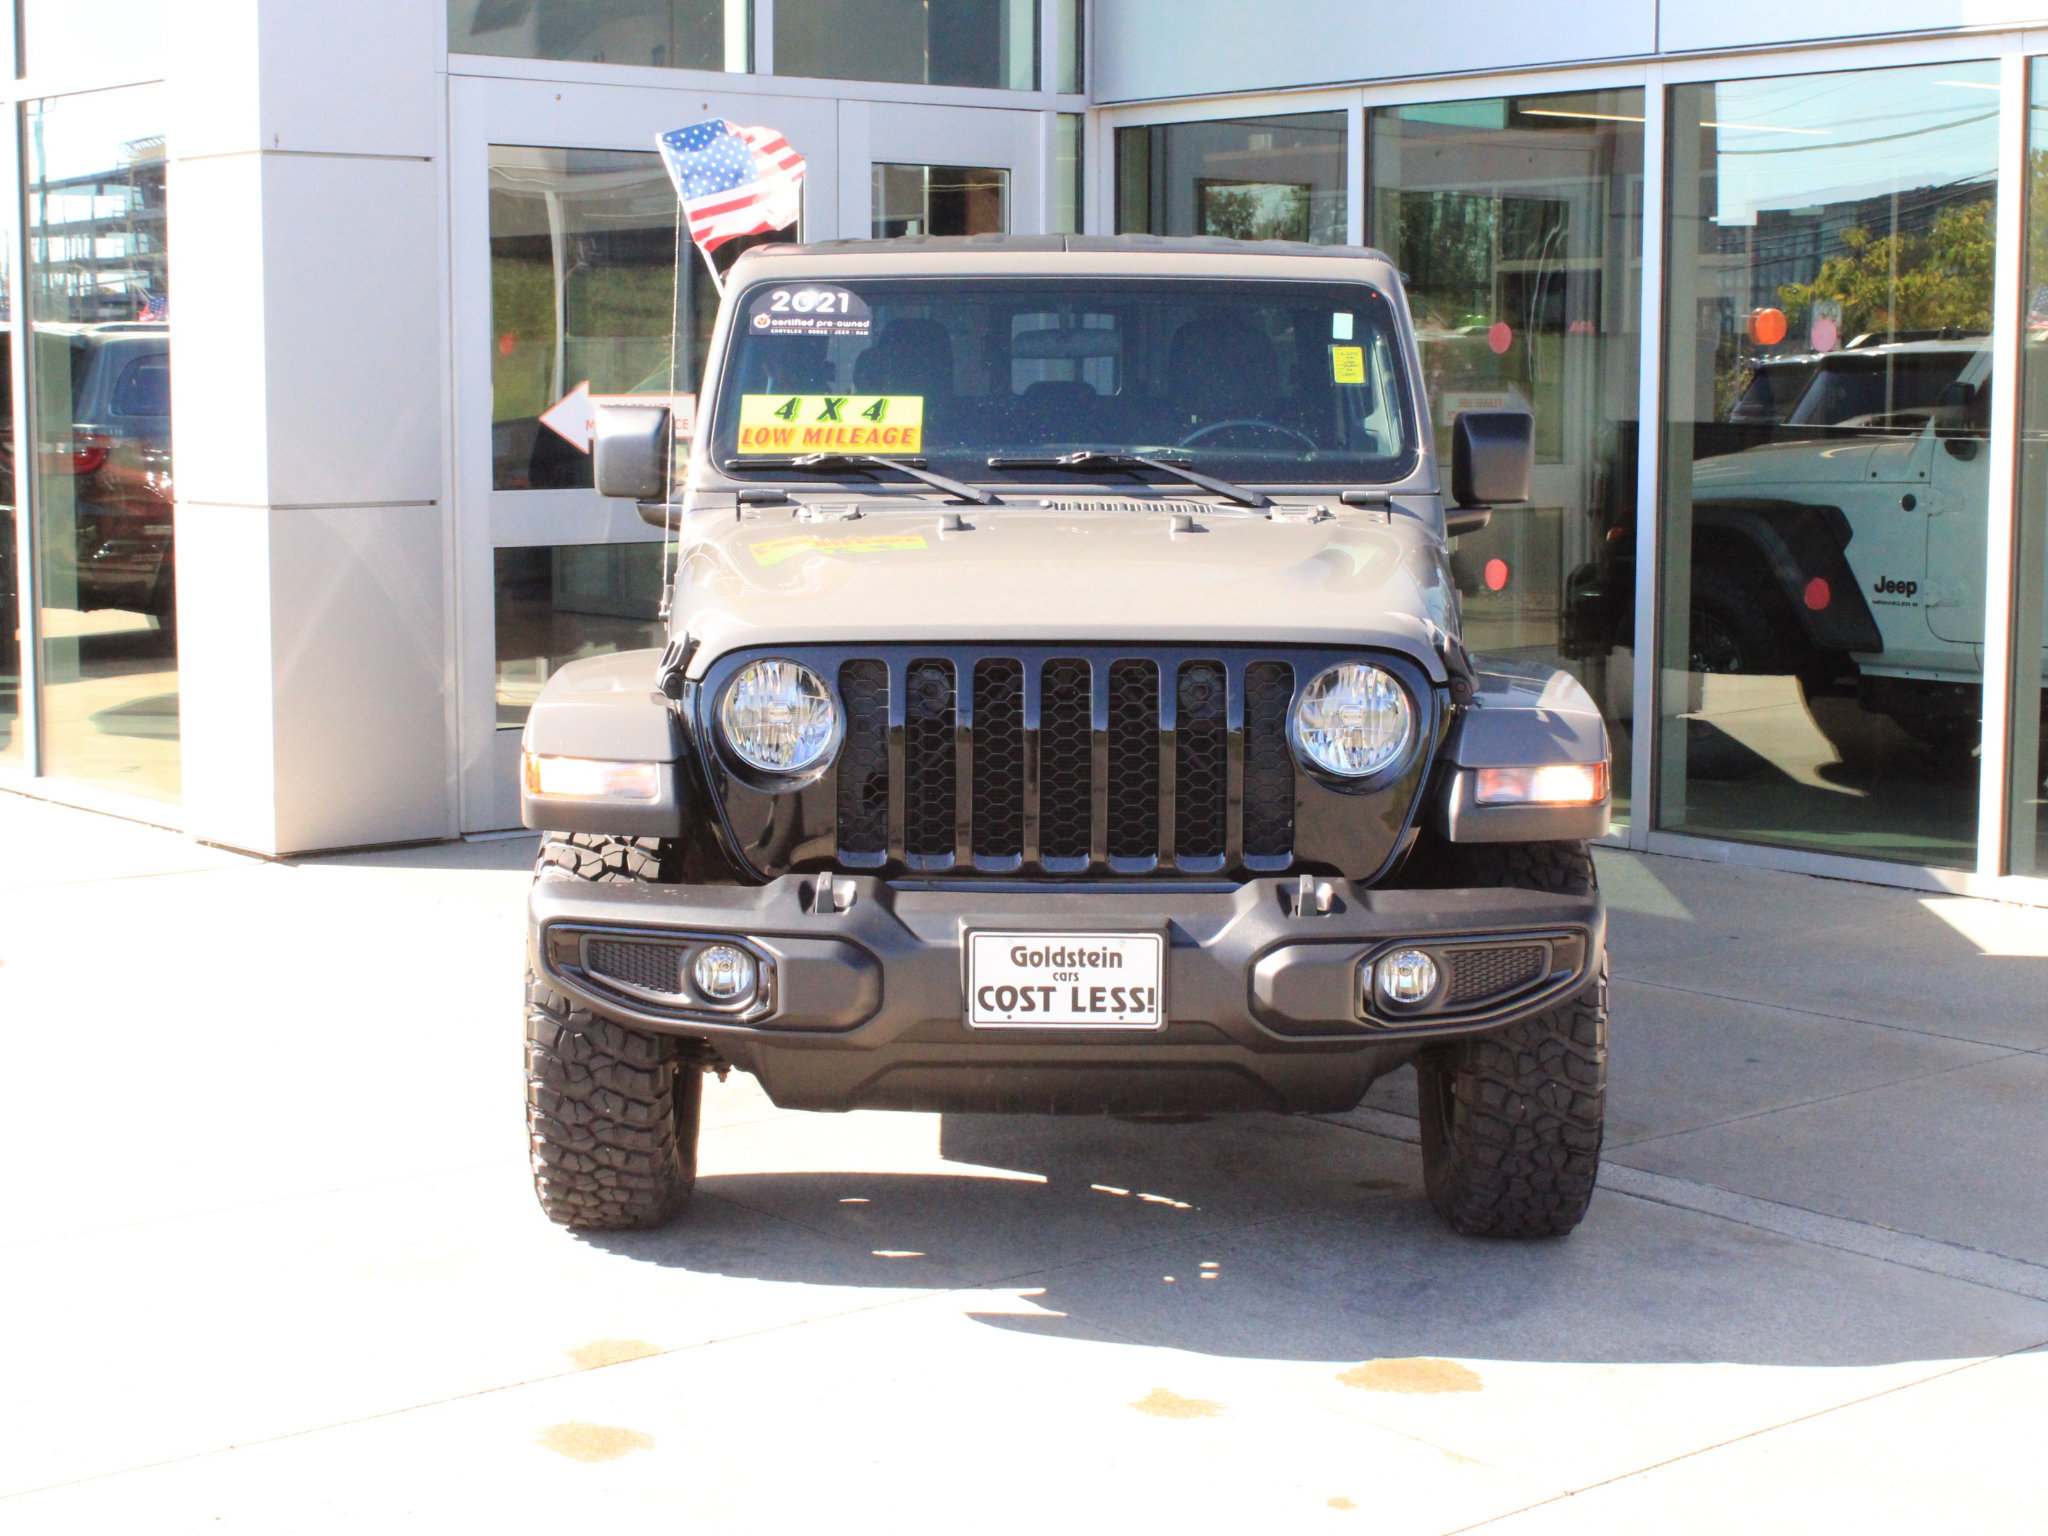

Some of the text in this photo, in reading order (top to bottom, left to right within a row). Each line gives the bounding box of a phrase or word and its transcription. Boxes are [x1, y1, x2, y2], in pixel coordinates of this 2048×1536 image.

[770, 290, 850, 313] 2021
[771, 318, 870, 329] certified pre-owned
[774, 397, 888, 423] 4 X 4
[741, 427, 917, 446] LOW MILEAGE
[1873, 575, 1918, 598] Jeep
[1010, 945, 1123, 968] Goldstein
[1052, 971, 1080, 982] cars
[977, 985, 1155, 1014] COST LESS!
